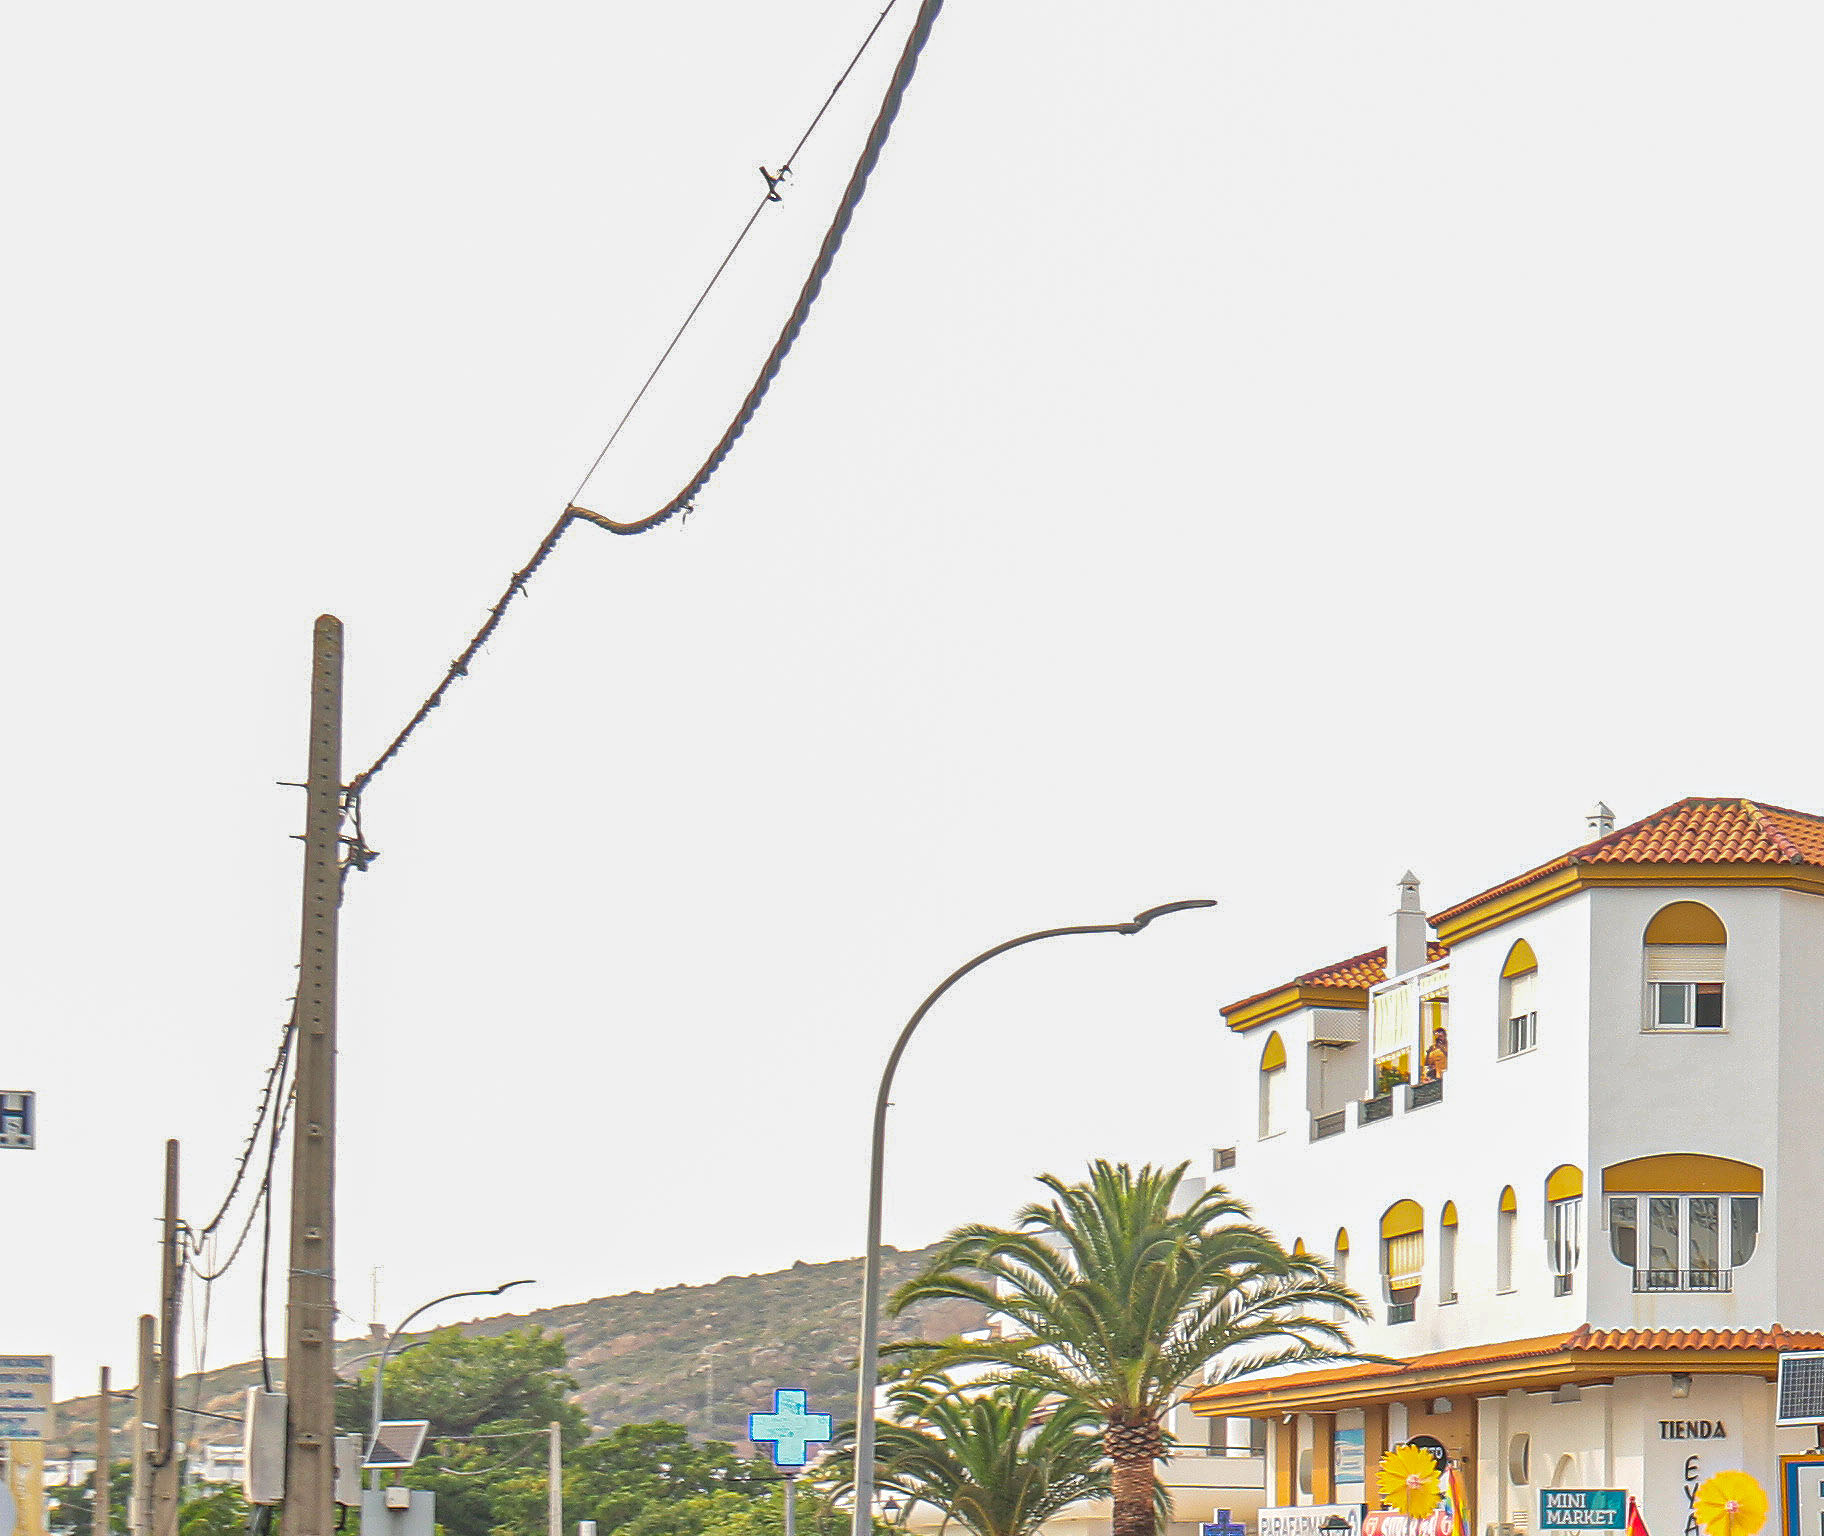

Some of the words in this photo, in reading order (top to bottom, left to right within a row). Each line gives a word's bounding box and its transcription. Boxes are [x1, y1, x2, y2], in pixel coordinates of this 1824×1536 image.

[1658, 1420, 1727, 1440] TIENDA
[1547, 1493, 1587, 1508] MINI
[1547, 1509, 1617, 1525] MARKET
